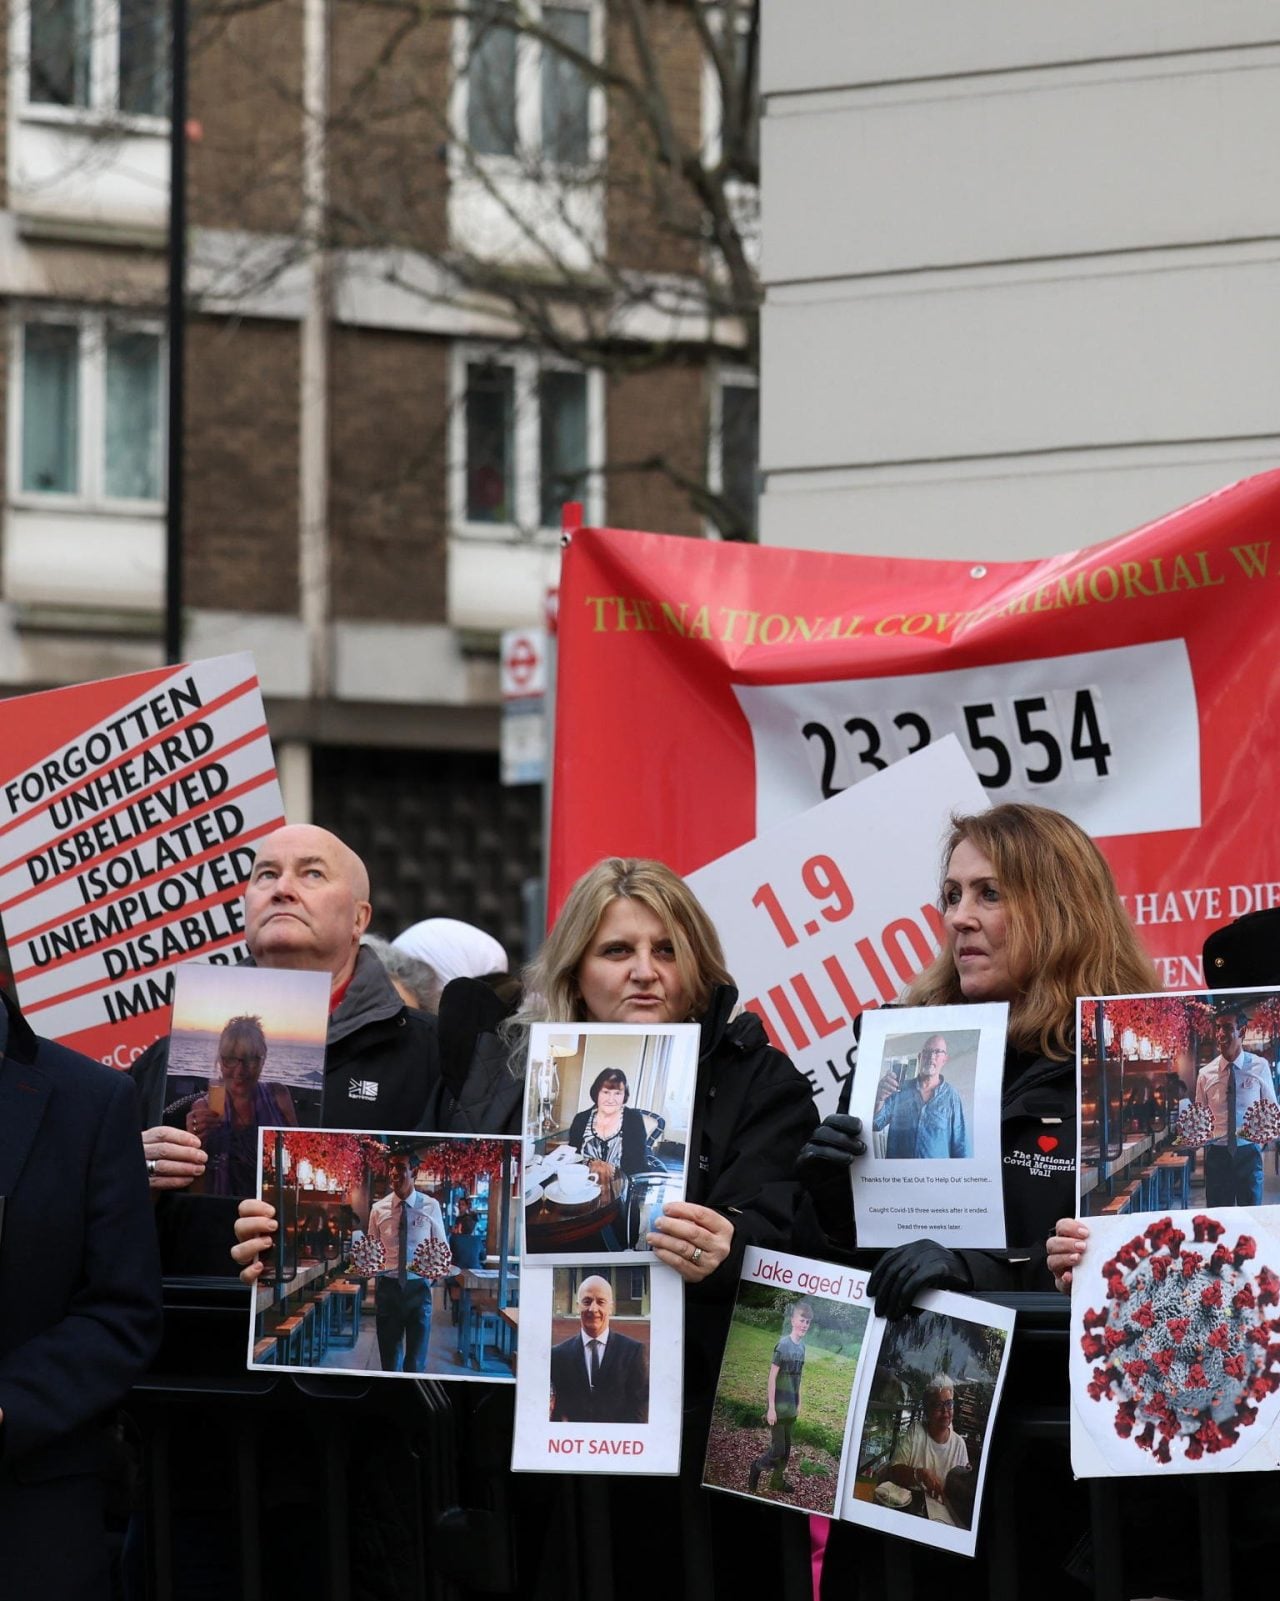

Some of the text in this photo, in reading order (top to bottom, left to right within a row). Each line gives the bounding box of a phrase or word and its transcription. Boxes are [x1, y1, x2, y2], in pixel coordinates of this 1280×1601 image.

[660, 602, 864, 646] NATIONAL
[997, 551, 1225, 619] MEMORIAL
[4, 677, 203, 814] FORGOTTEN
[48, 721, 215, 830] UNHEARD
[27, 762, 229, 886] DISBELIEVED
[77, 804, 244, 903] ISOLATED
[28, 846, 257, 967] UNEMPLOYED
[752, 854, 855, 948] 1.9
[1135, 888, 1222, 925] HAVE
[1003, 1156, 1032, 1168] Covid
[1013, 1150, 1075, 1165] The National
[1029, 1167, 1051, 1178] Wall
[861, 1176, 881, 1184] Thanks
[883, 1176, 891, 1184] for
[892, 1176, 901, 1184] the
[914, 1176, 925, 1184] Out
[926, 1176, 934, 1184] To
[935, 1176, 948, 1185] Help
[869, 1207, 889, 1215] Caught
[752, 1258, 866, 1300] Jake aged 15
[548, 1438, 645, 1456] NOT SAVED
